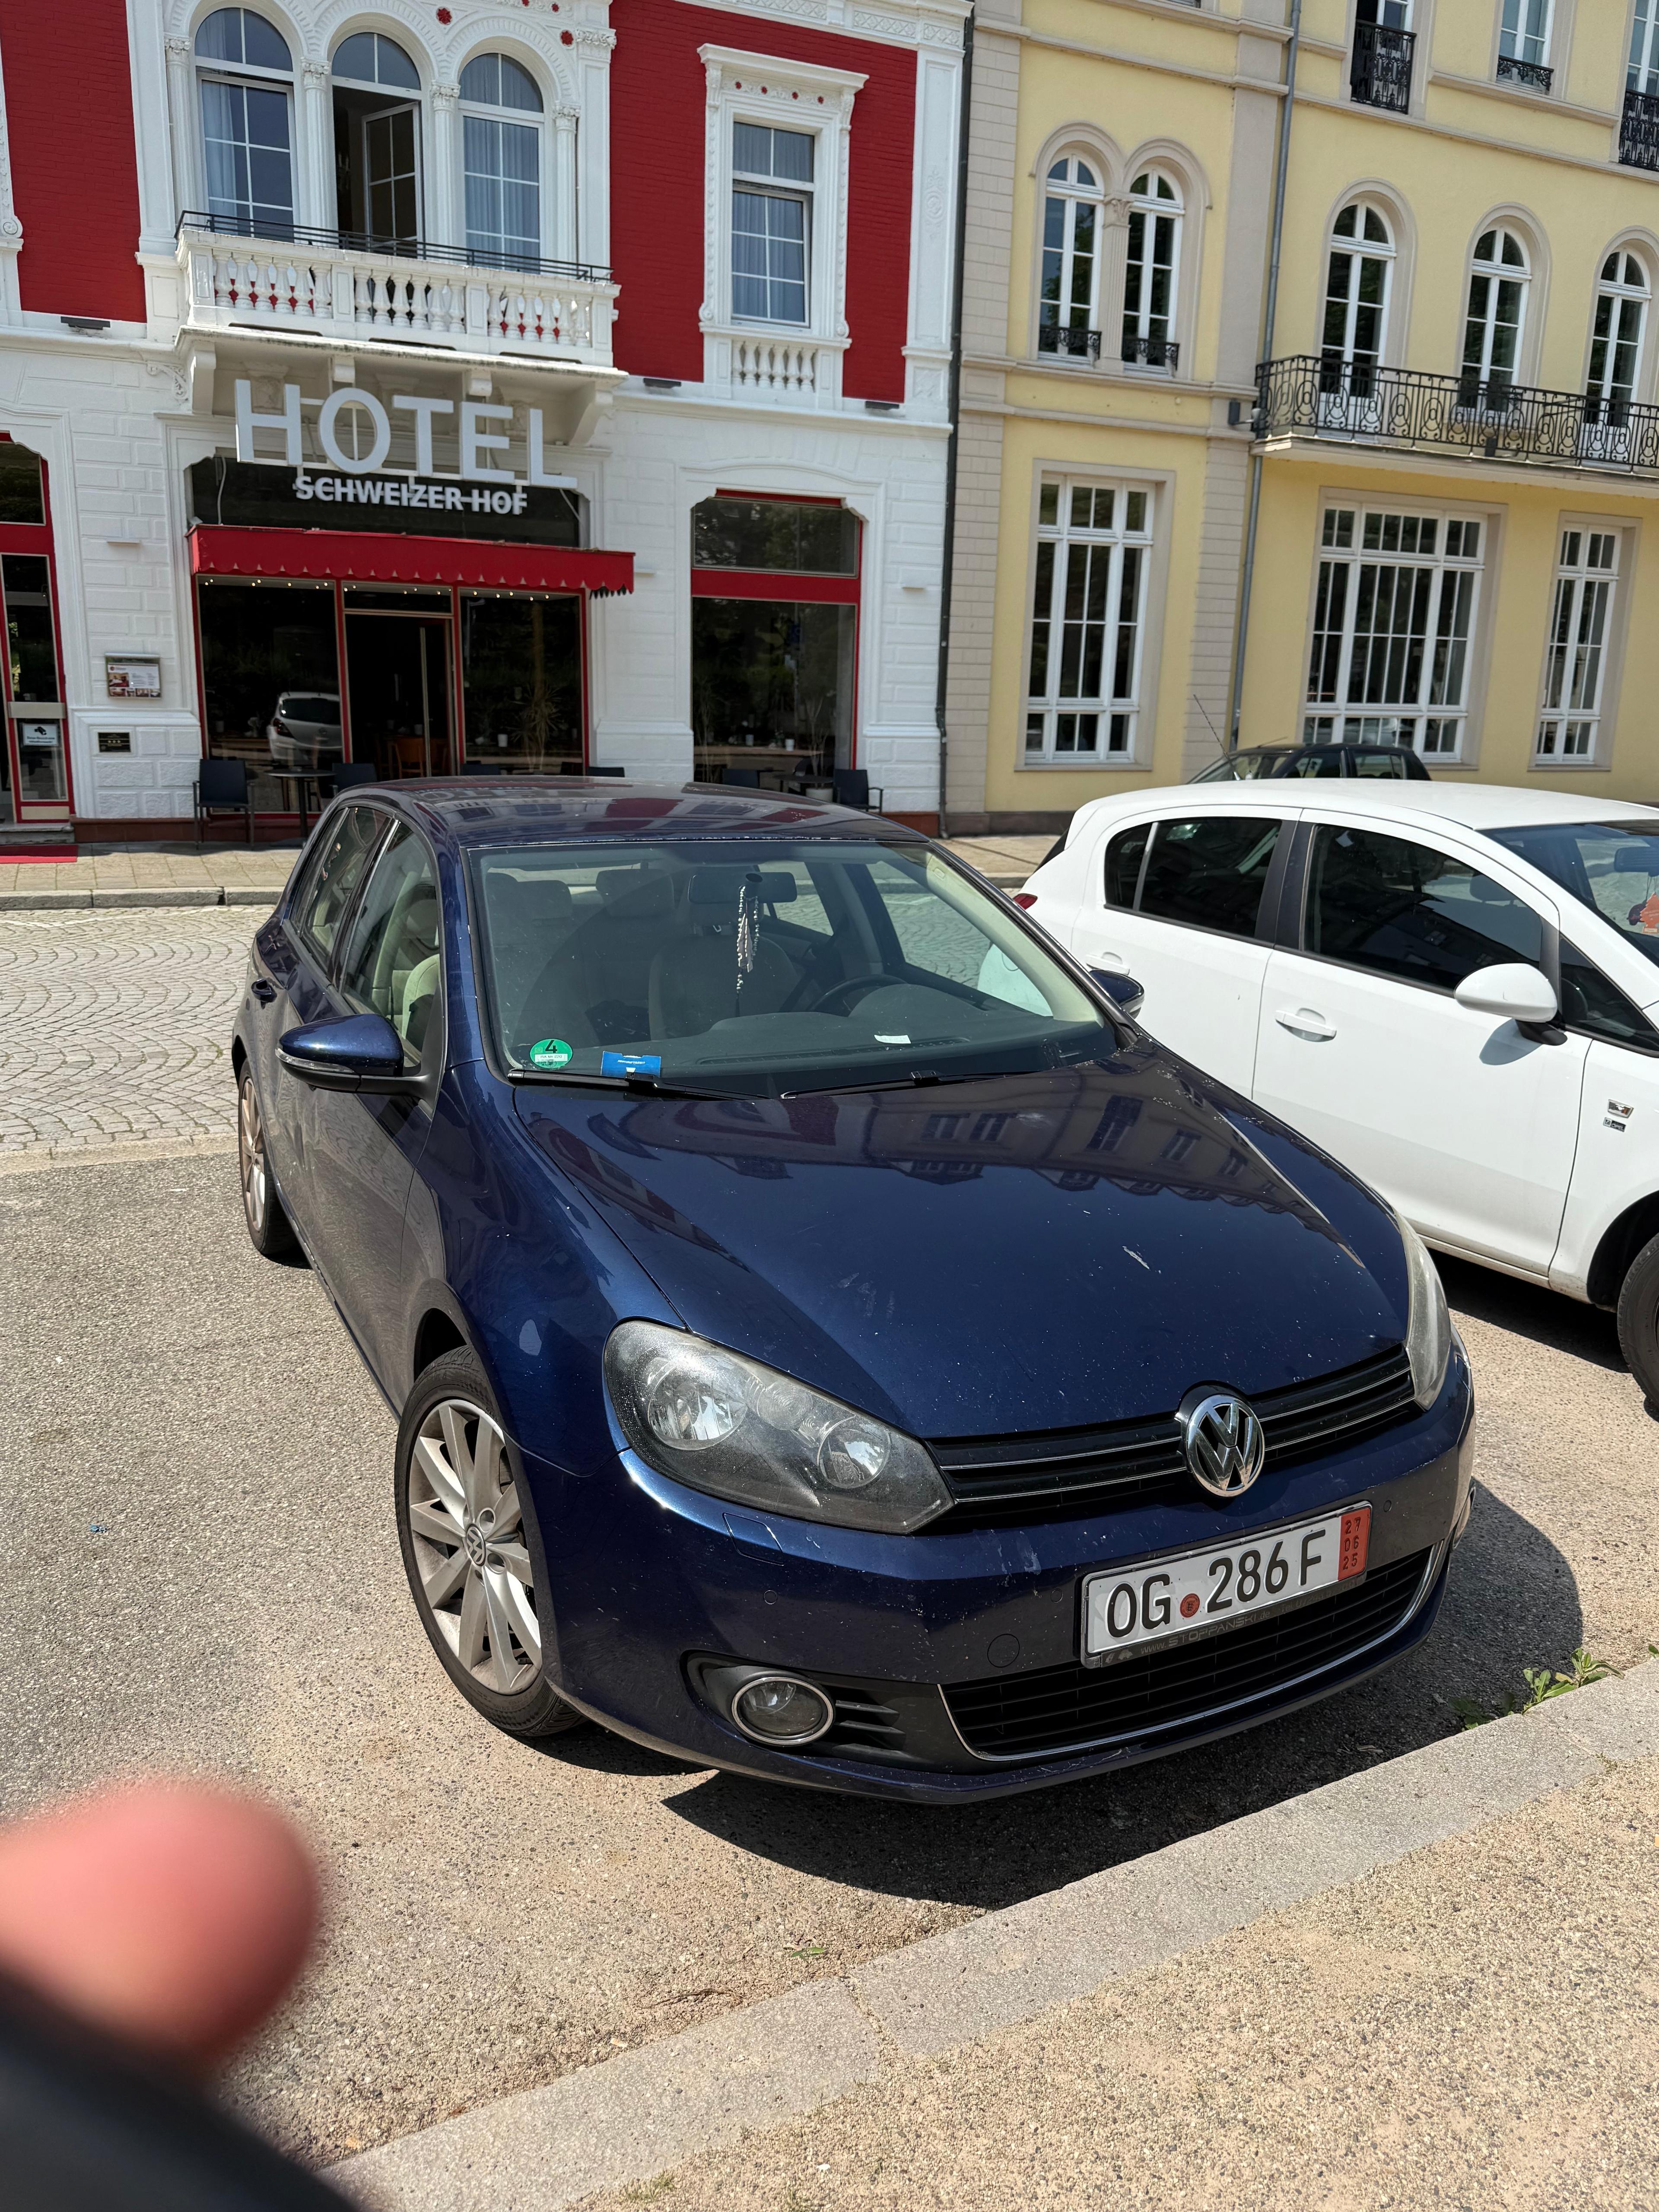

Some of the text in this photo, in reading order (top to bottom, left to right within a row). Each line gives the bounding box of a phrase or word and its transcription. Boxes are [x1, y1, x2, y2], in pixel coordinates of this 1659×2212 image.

[234, 379, 577, 489] HOTEL
[295, 475, 528, 515] SCHWEIZER HOF
[545, 1039, 557, 1053] 4
[1345, 1516, 1361, 1534] 27
[1344, 1535, 1359, 1552] 06
[1343, 1552, 1358, 1570] 25
[1107, 1573, 1171, 1638] OG
